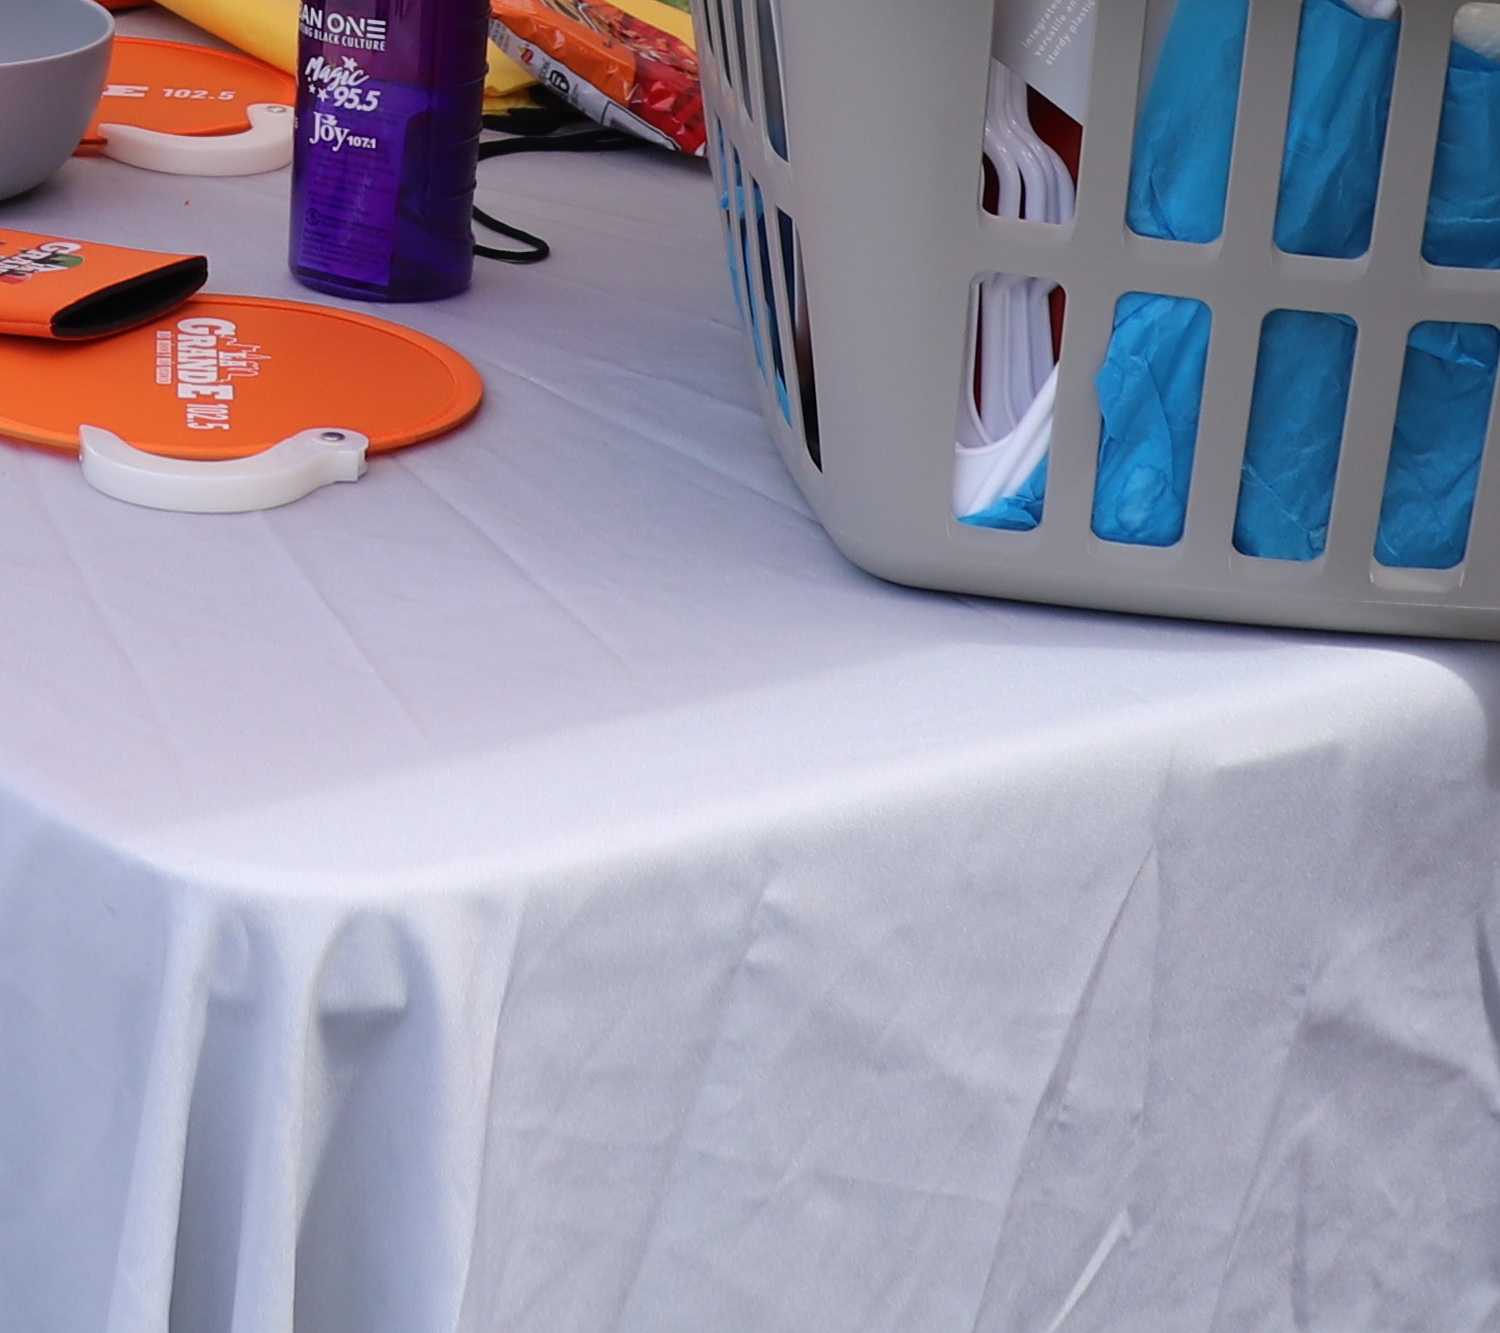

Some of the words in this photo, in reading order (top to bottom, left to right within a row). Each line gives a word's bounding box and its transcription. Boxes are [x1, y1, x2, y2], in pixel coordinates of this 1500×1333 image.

[313, 28, 340, 46] BLACK
[341, 32, 386, 52] CULTURE
[326, 12, 387, 41] ONE
[1033, 13, 1067, 57] versatile
[1045, 33, 1071, 66] sturdy
[304, 55, 371, 93] Magic
[161, 87, 237, 101] 102.5
[332, 86, 382, 112] 95.5
[308, 111, 350, 152] Joy
[346, 135, 377, 150] 107.1
[176, 316, 237, 401] GRANDE
[186, 403, 230, 430] 102.5
